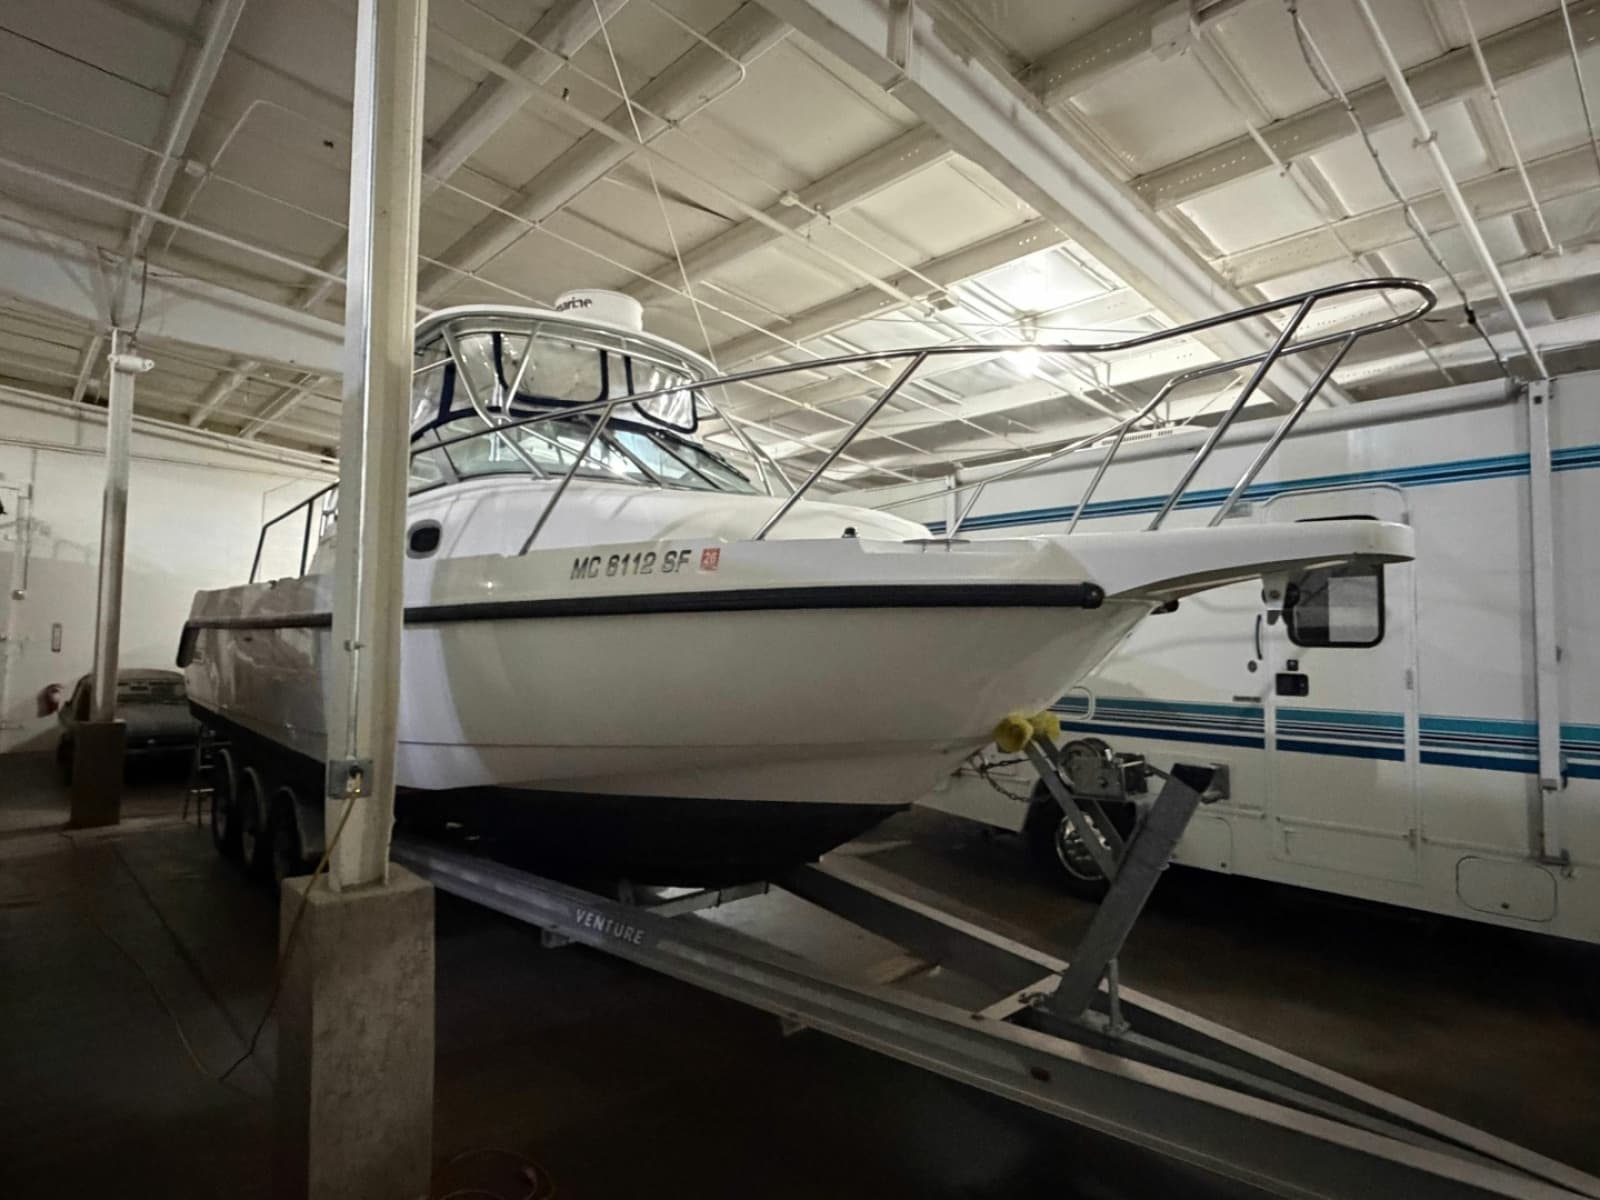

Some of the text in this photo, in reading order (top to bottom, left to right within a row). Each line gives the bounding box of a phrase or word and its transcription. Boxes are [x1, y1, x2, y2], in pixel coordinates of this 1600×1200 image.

[570, 556, 601, 580] MC
[661, 549, 691, 573] SF
[576, 908, 645, 945] VENTURE
